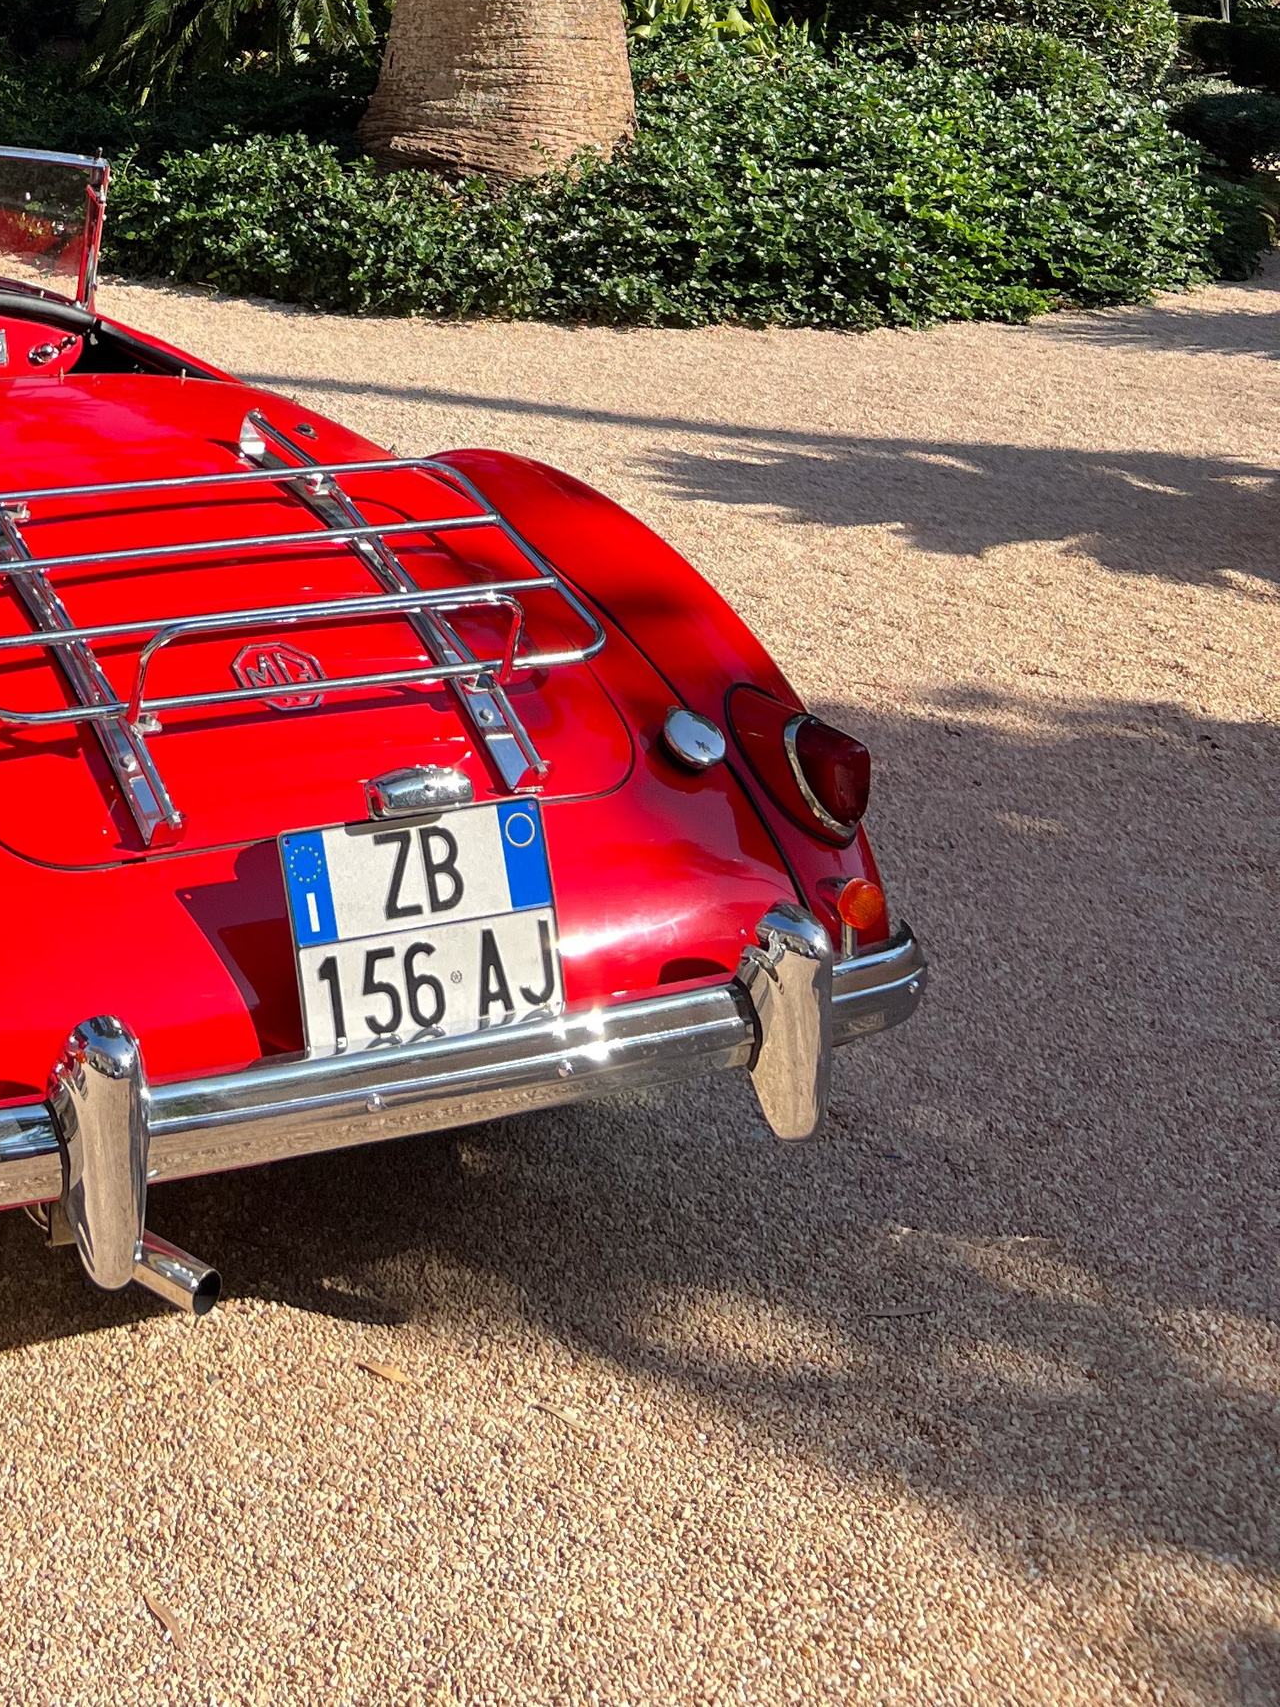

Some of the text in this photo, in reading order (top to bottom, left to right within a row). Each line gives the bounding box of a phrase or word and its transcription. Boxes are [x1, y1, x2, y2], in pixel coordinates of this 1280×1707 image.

[245, 651, 318, 702] MG
[372, 825, 465, 921] ZB
[318, 918, 556, 1040] 156 AJ
